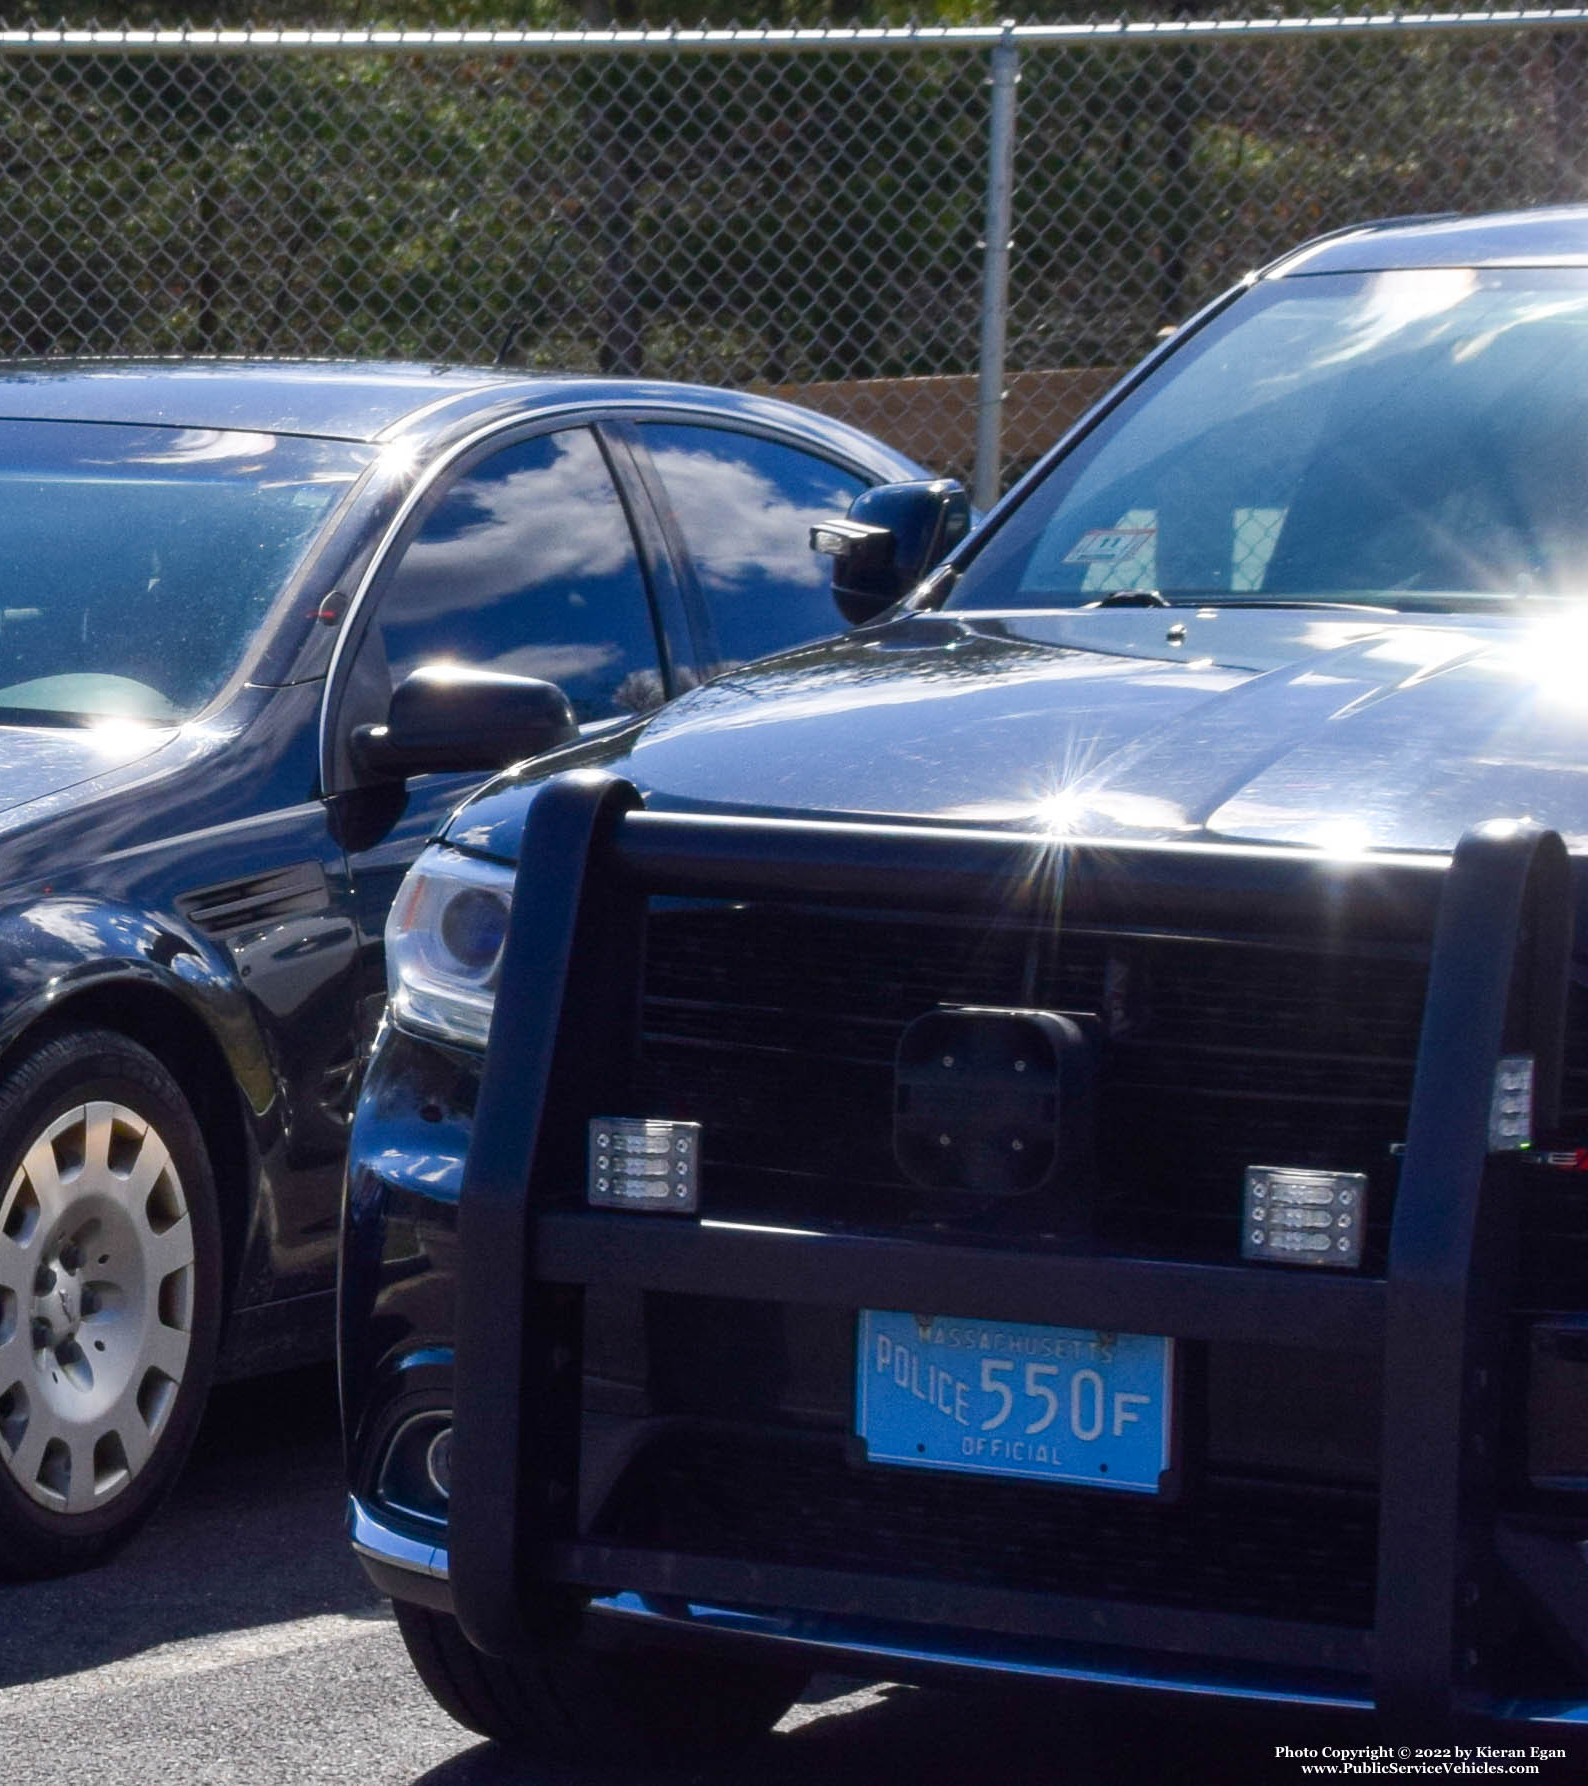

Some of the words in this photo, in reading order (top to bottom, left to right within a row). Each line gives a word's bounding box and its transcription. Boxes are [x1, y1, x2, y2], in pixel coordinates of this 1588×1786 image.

[918, 1325, 1113, 1363] MASSACHUSETTS
[877, 1334, 971, 1427] POLICE
[962, 1435, 1062, 1465] OFFICIAL
